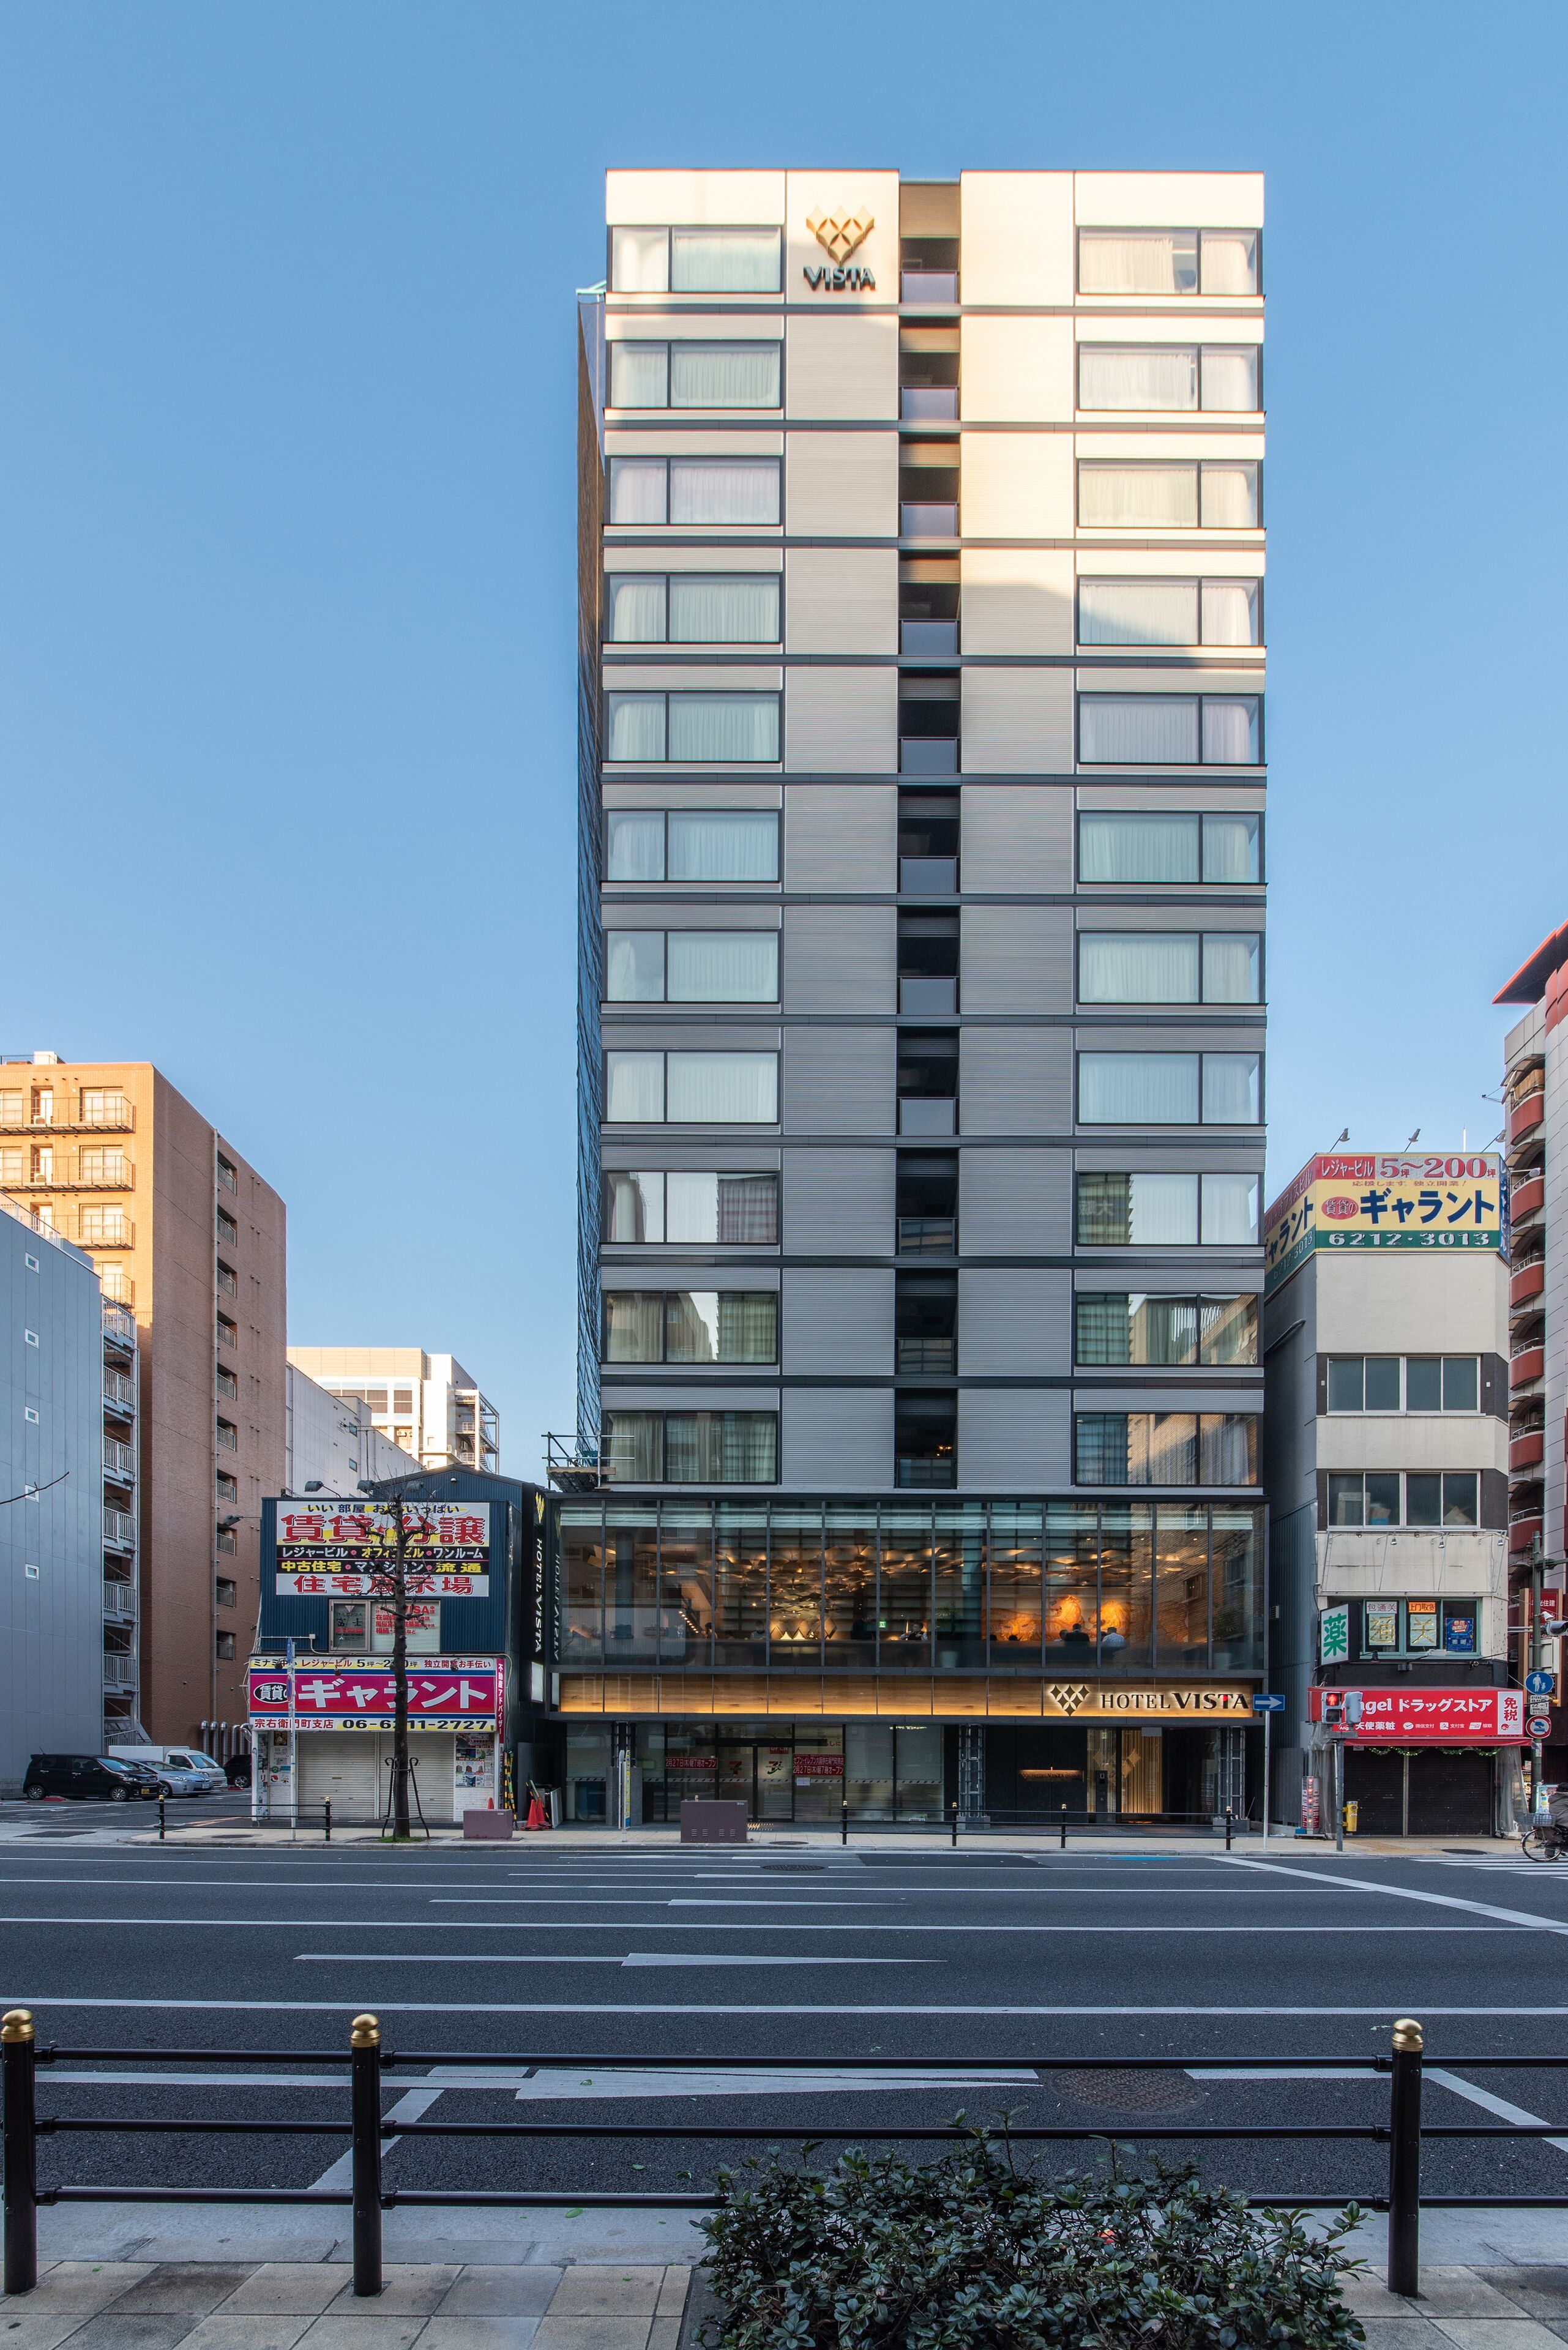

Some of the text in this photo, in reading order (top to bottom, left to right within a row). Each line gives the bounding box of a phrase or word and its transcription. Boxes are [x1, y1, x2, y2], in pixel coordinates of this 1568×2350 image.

[803, 266, 876, 292] VISTA
[1321, 1158, 1373, 1177] レジャービル
[1324, 1187, 1495, 1225] 賃貸の ギャラント
[1265, 1195, 1314, 1264] ャラント
[280, 1514, 375, 1543] 賃貸
[282, 1547, 348, 1558] レジャービル
[433, 1548, 483, 1559] ワンルーム
[281, 1561, 342, 1572] 中古住宅
[435, 1562, 482, 1573] 流通
[1323, 1613, 1347, 1658] 薬
[1411, 1617, 1436, 1644] 关
[253, 1659, 297, 1668] ミナミ中
[298, 1678, 488, 1709] ギャラント
[1101, 1692, 1250, 1709] HOTEL VISTA
[1399, 1698, 1493, 1712] ドラッグストア
[1503, 1696, 1518, 1721] 免税
[342, 1719, 488, 1730] 06-611-2727
